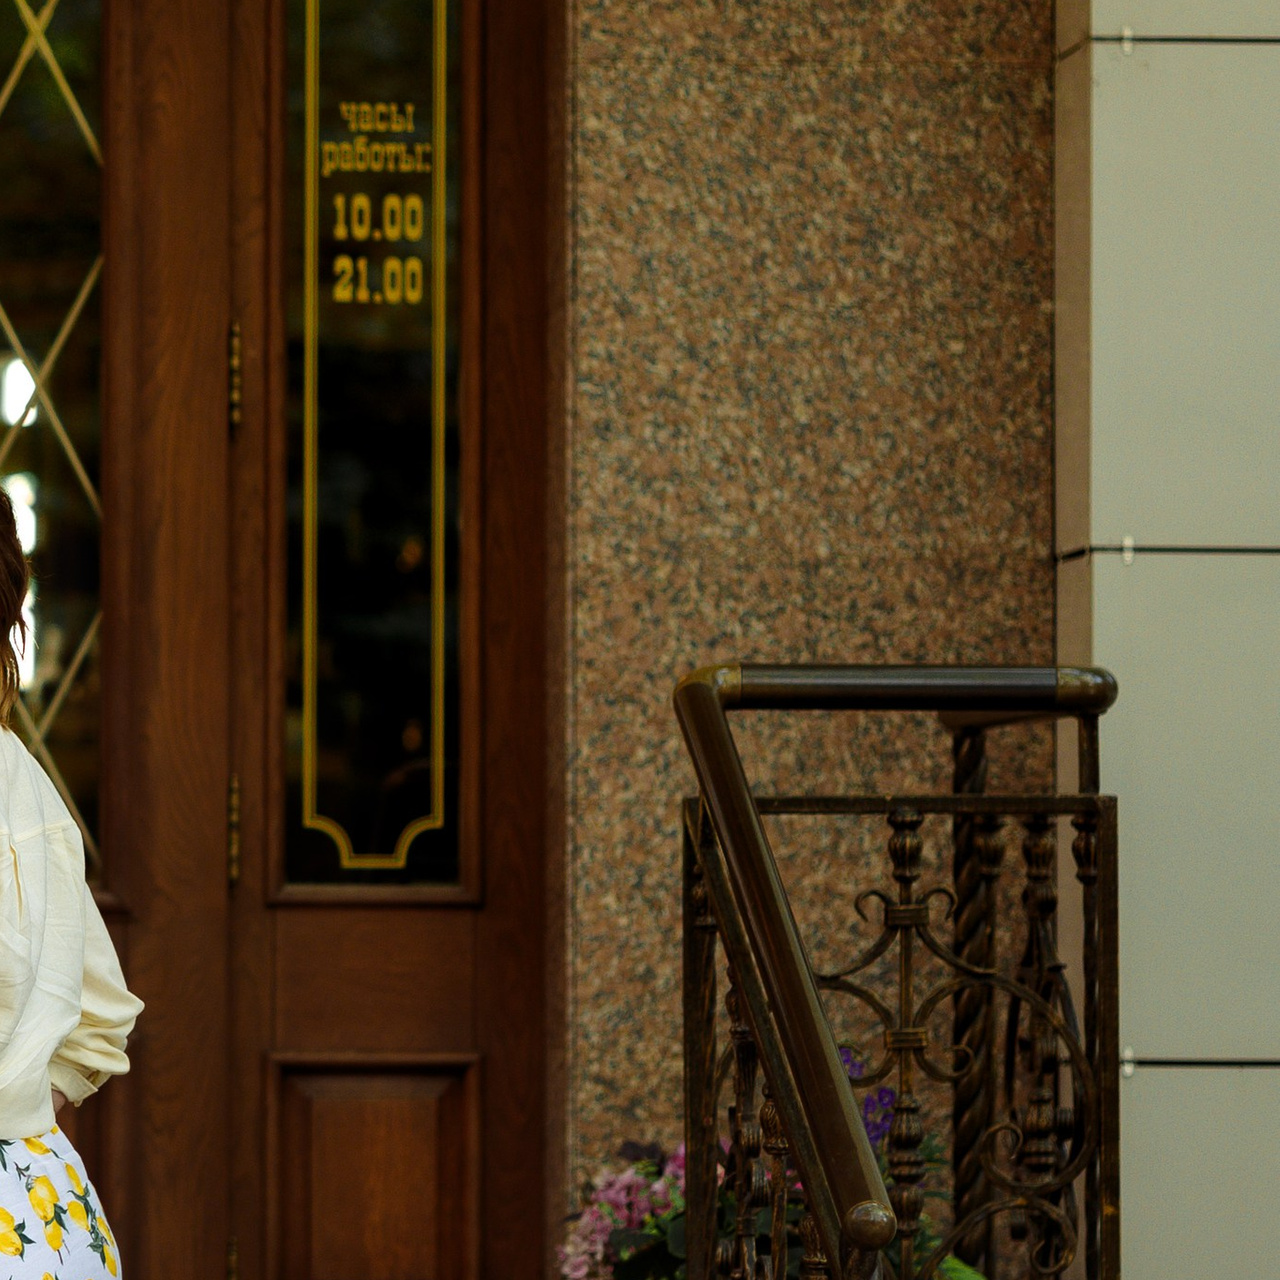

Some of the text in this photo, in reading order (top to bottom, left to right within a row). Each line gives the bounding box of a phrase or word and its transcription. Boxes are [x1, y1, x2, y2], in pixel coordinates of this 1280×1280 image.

[339, 102, 414, 132] часы
[333, 193, 424, 242] 10.00
[333, 254, 424, 304] 21.00
